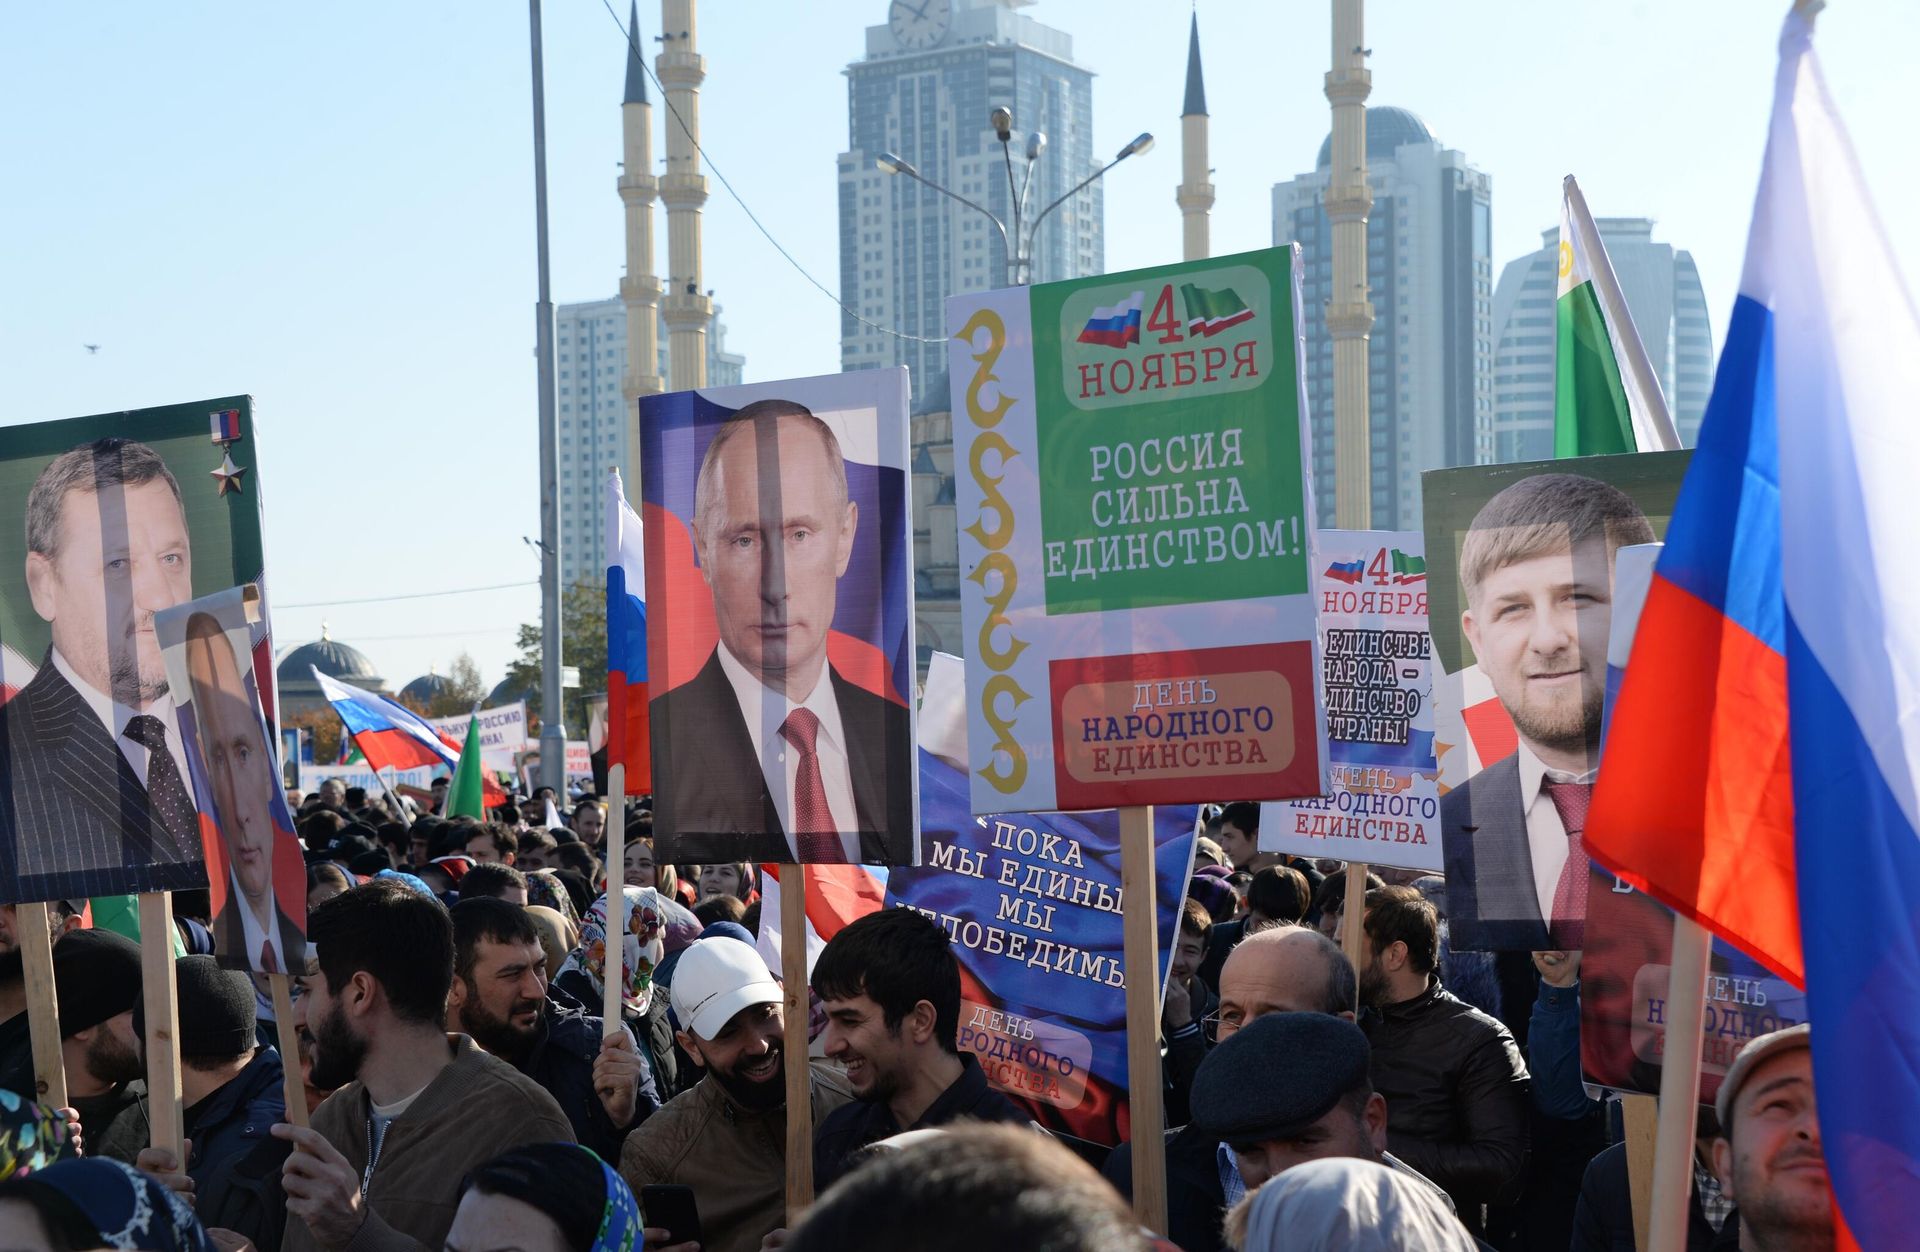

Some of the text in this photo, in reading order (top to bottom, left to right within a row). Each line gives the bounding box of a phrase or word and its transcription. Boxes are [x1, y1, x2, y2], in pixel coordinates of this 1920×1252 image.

[1146, 283, 1184, 345] 4
[1078, 340, 1258, 398] НОЯБРЯ
[1089, 428, 1244, 482] РОССИЯ
[1091, 477, 1249, 528] СИЛЬНА
[1045, 515, 1300, 582] ЕДИНСТВОМ!
[1367, 547, 1389, 586] 4
[1322, 591, 1428, 616] НОЯБРЯ
[1132, 679, 1217, 712] ДЕНЬ
[1325, 688, 1420, 717] ДИНСТВО
[1082, 705, 1274, 742] НАРОДНОГО
[1092, 739, 1268, 775] ЕДИНСТВА
[1331, 765, 1397, 789] ДЕНЬ
[991, 820, 1084, 869] ПОКА
[1295, 813, 1428, 845] ЕДИНСТВА
[929, 840, 988, 879] МЫ
[995, 893, 1057, 933] МЫ
[968, 1005, 1035, 1041] ДЕНЬ
